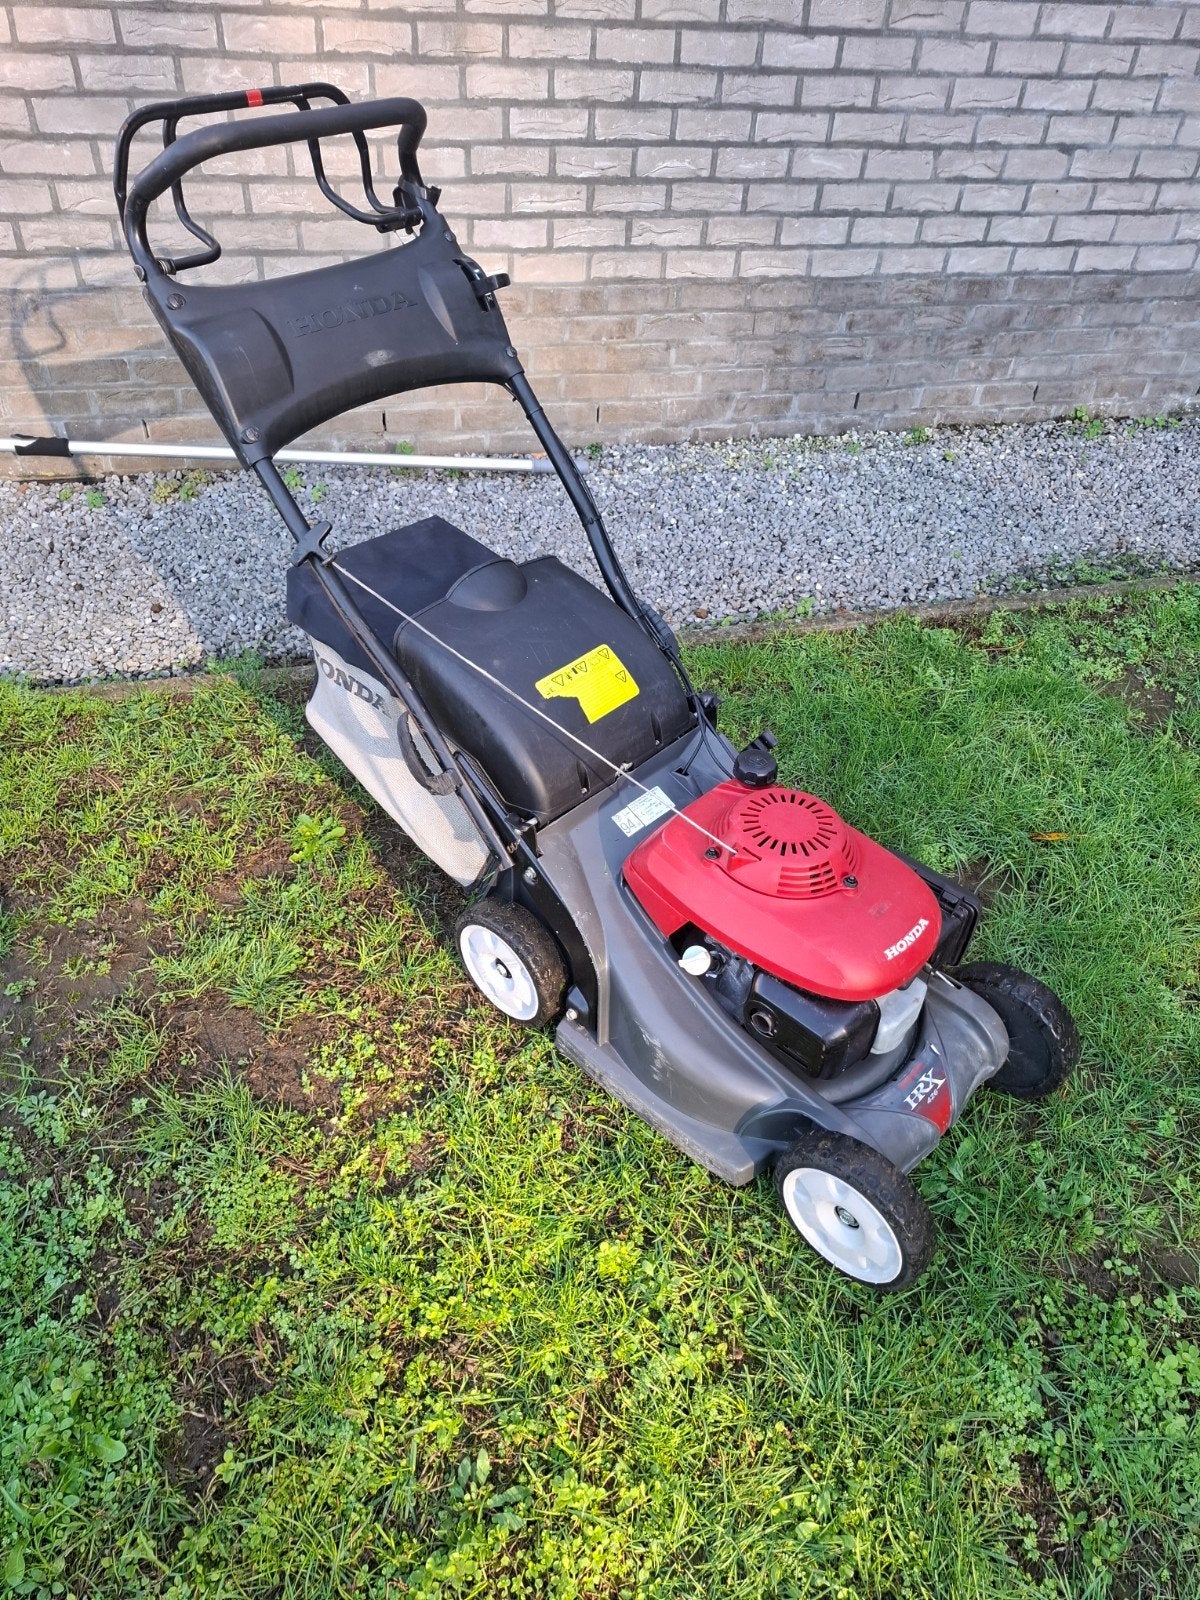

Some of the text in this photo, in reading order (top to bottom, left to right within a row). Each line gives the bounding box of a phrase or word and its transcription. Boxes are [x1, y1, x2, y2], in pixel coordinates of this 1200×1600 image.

[287, 291, 418, 337] HONDA
[315, 650, 392, 719] ONDA
[884, 918, 929, 960] HONDA
[904, 1067, 946, 1110] HRX
